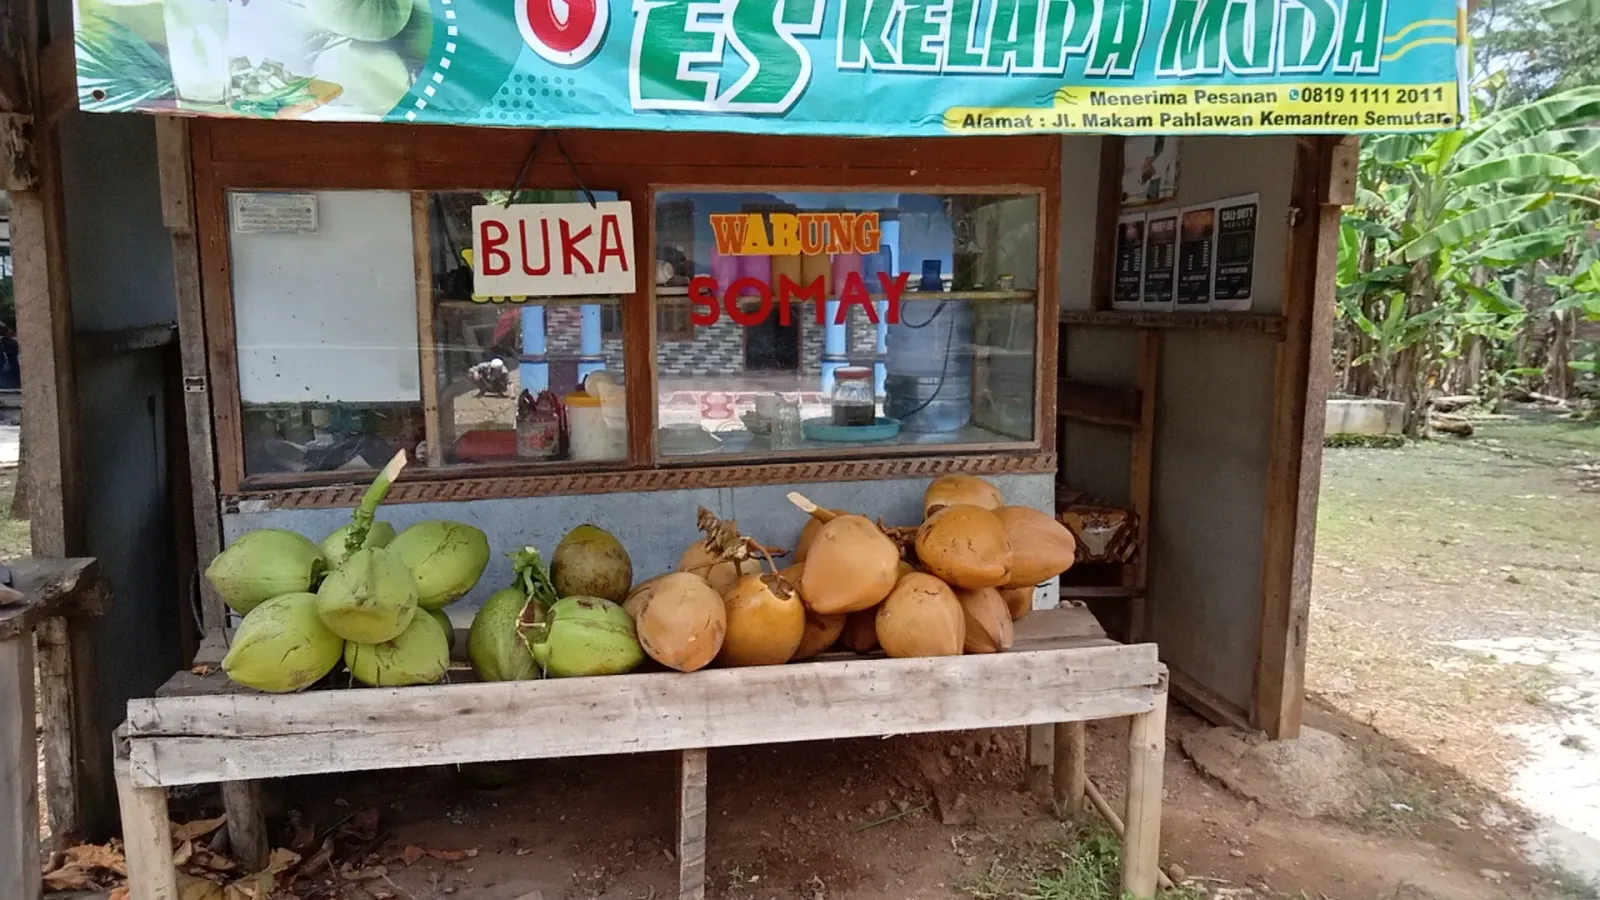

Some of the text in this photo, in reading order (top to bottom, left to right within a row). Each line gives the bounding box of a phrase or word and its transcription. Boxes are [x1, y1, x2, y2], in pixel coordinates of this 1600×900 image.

[630, 0, 826, 113] ES
[836, 0, 1147, 76] KELAPA
[1154, 0, 1385, 77] MUDA
[962, 113, 1033, 129] Alamat
[1082, 113, 1153, 128] Makam
[1159, 112, 1254, 128] Pahlawan
[1259, 110, 1359, 127] Kemantren
[1090, 86, 1443, 107] Menerima Pesanan 0819 1111 2011
[480, 214, 630, 276] BUKA
[689, 271, 910, 327] SOMAY
